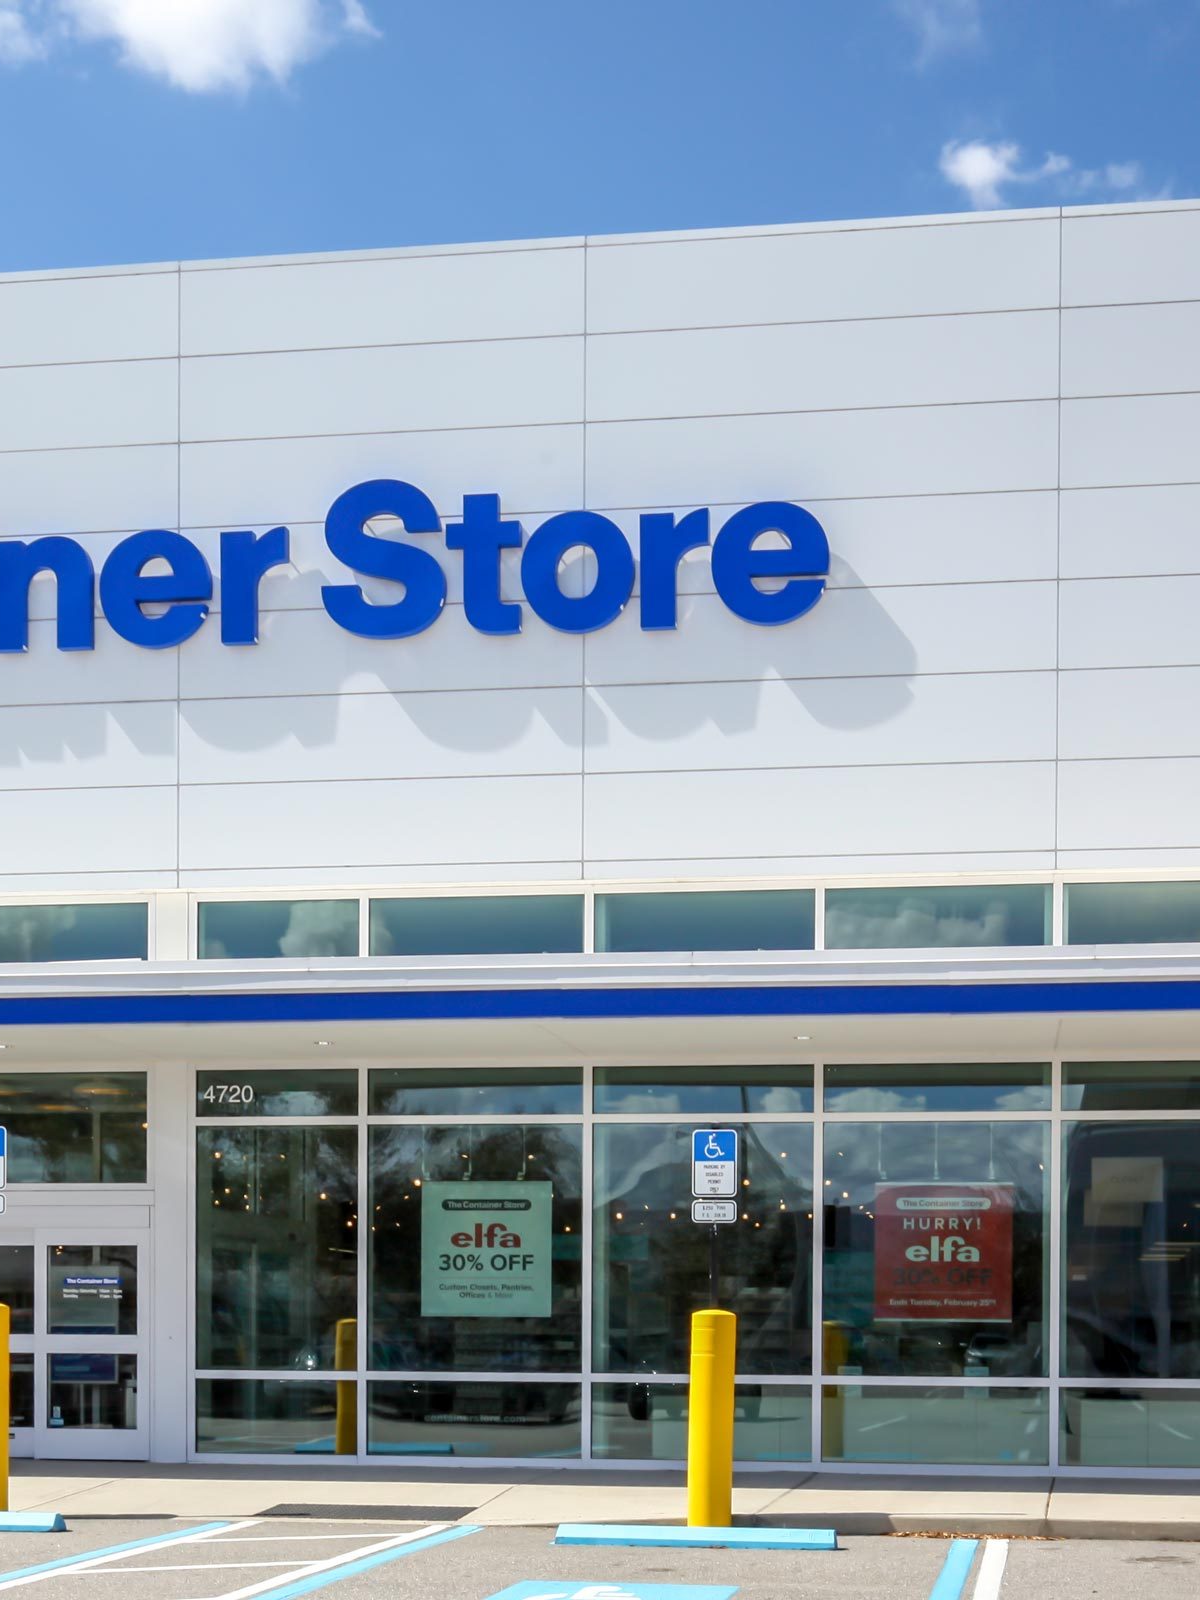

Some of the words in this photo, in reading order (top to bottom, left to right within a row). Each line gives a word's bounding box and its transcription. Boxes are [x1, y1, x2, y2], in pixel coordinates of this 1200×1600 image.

[321, 479, 830, 640] Store
[203, 1084, 254, 1103] 4720
[447, 1200, 462, 1209] The
[462, 1200, 503, 1209] Container
[503, 1200, 526, 1209] Store
[919, 1199, 960, 1207] Container
[903, 1217, 982, 1230] HURRY!
[450, 1222, 522, 1248] elfa
[905, 1235, 980, 1262] elfa
[438, 1253, 484, 1272] 30%
[490, 1253, 535, 1272] OFF
[439, 1283, 468, 1291] Custom
[469, 1283, 500, 1291] Closets,
[501, 1283, 535, 1291] Pantries,
